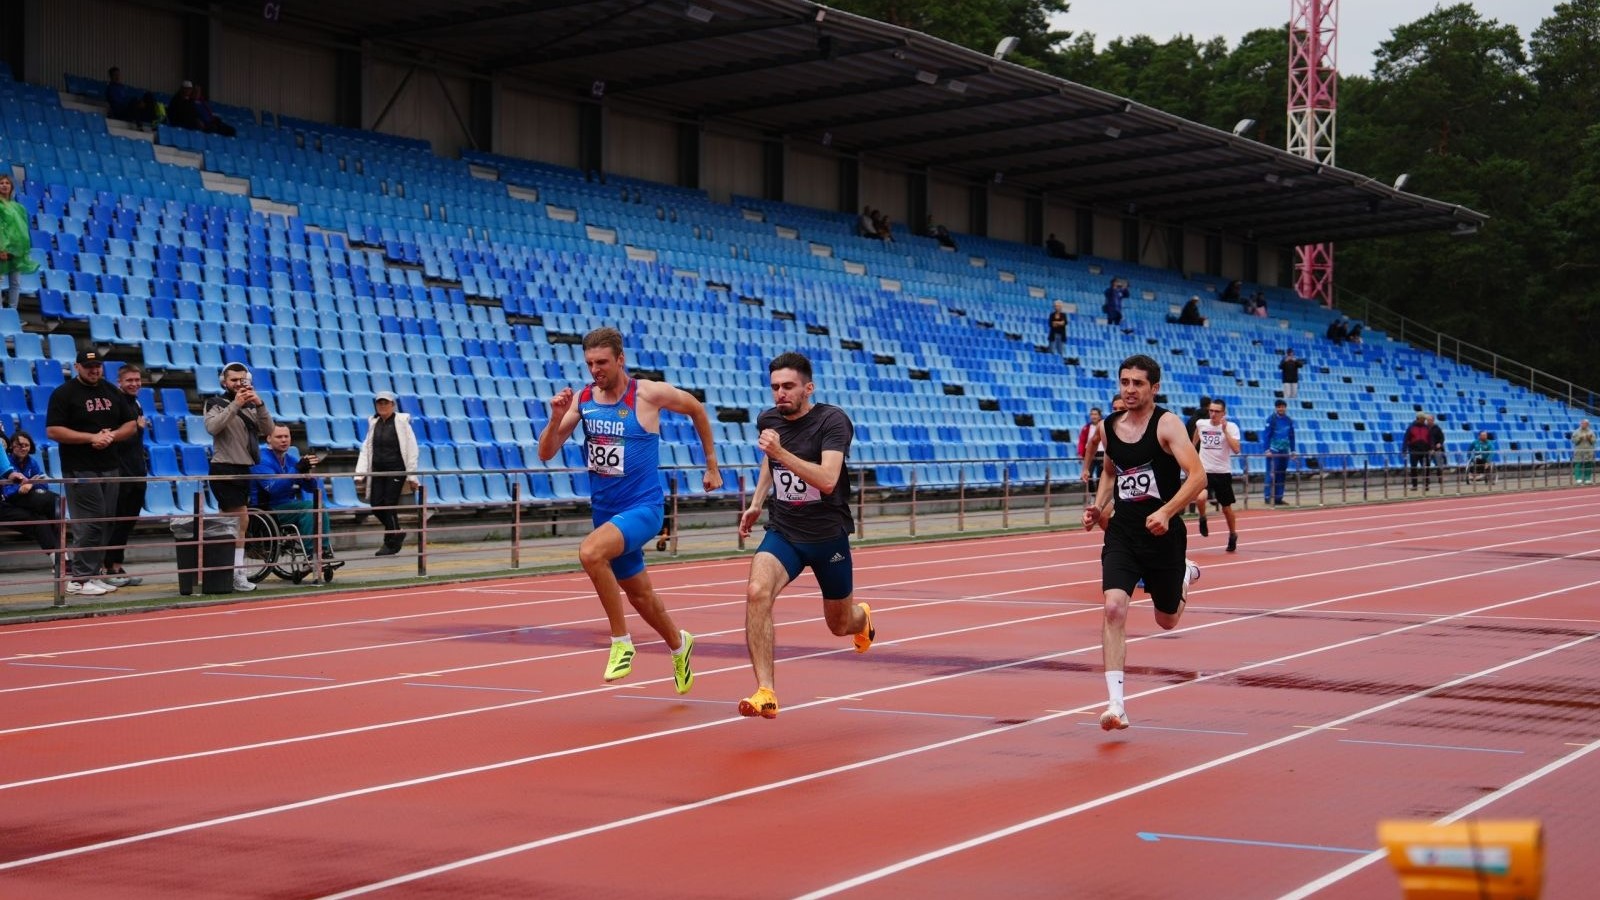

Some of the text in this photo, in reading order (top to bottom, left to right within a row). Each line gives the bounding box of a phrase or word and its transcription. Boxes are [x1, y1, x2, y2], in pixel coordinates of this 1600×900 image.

[85, 397, 113, 412] GAP
[1202, 436, 1221, 446] 398
[589, 444, 619, 467] 386
[779, 472, 807, 494] 93
